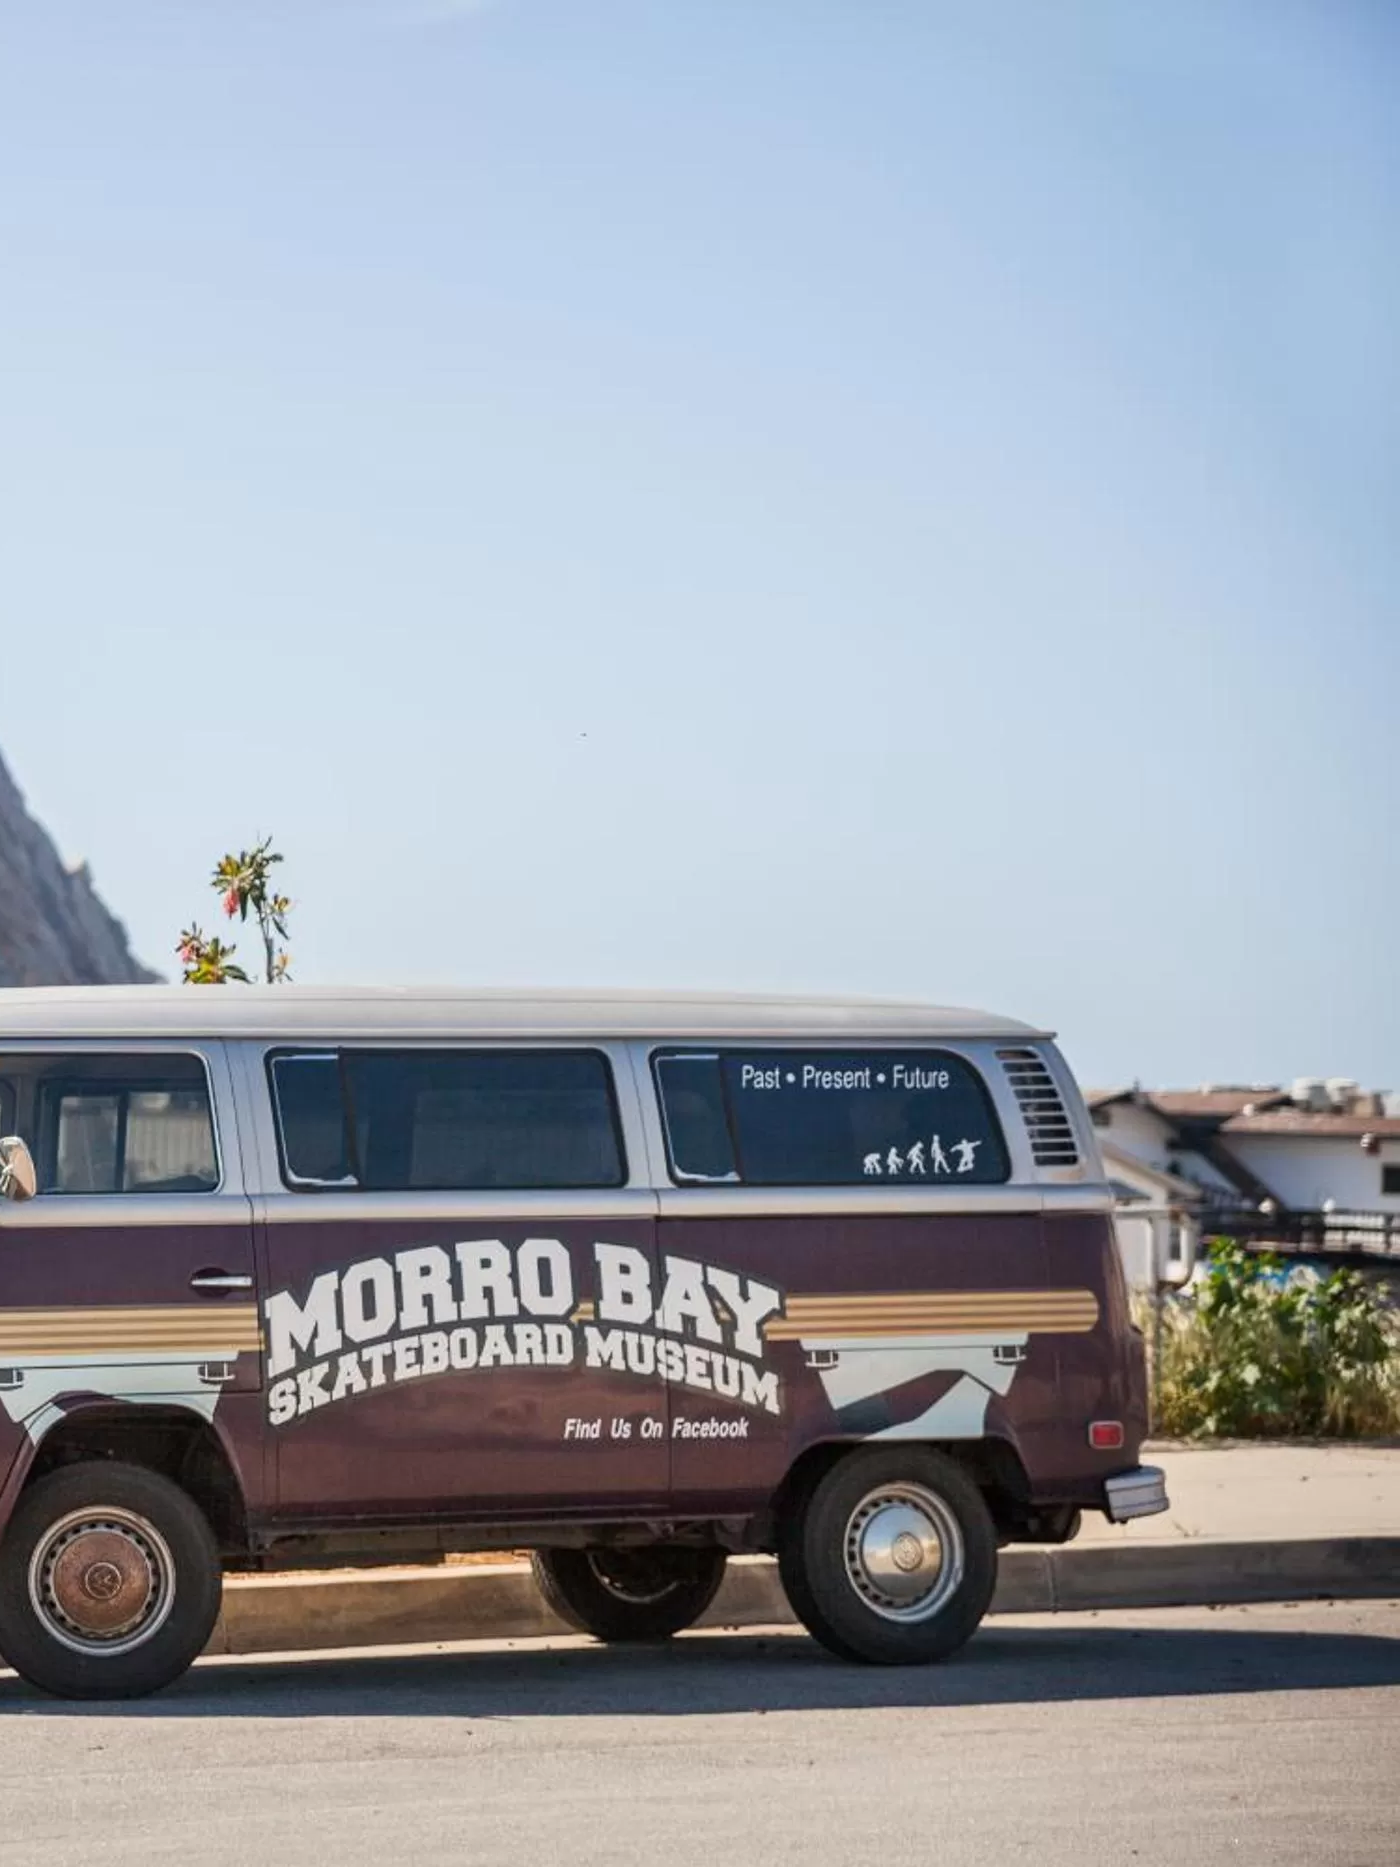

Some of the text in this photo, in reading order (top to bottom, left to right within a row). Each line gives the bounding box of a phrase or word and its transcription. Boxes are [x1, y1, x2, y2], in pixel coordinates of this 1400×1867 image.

[742, 1065, 949, 1089] Past Present Future
[264, 1238, 781, 1379] MORRO BAY
[267, 1323, 781, 1425] SKATEBOARD MUSEUM
[563, 1417, 749, 1439] Find Us On Facebook
